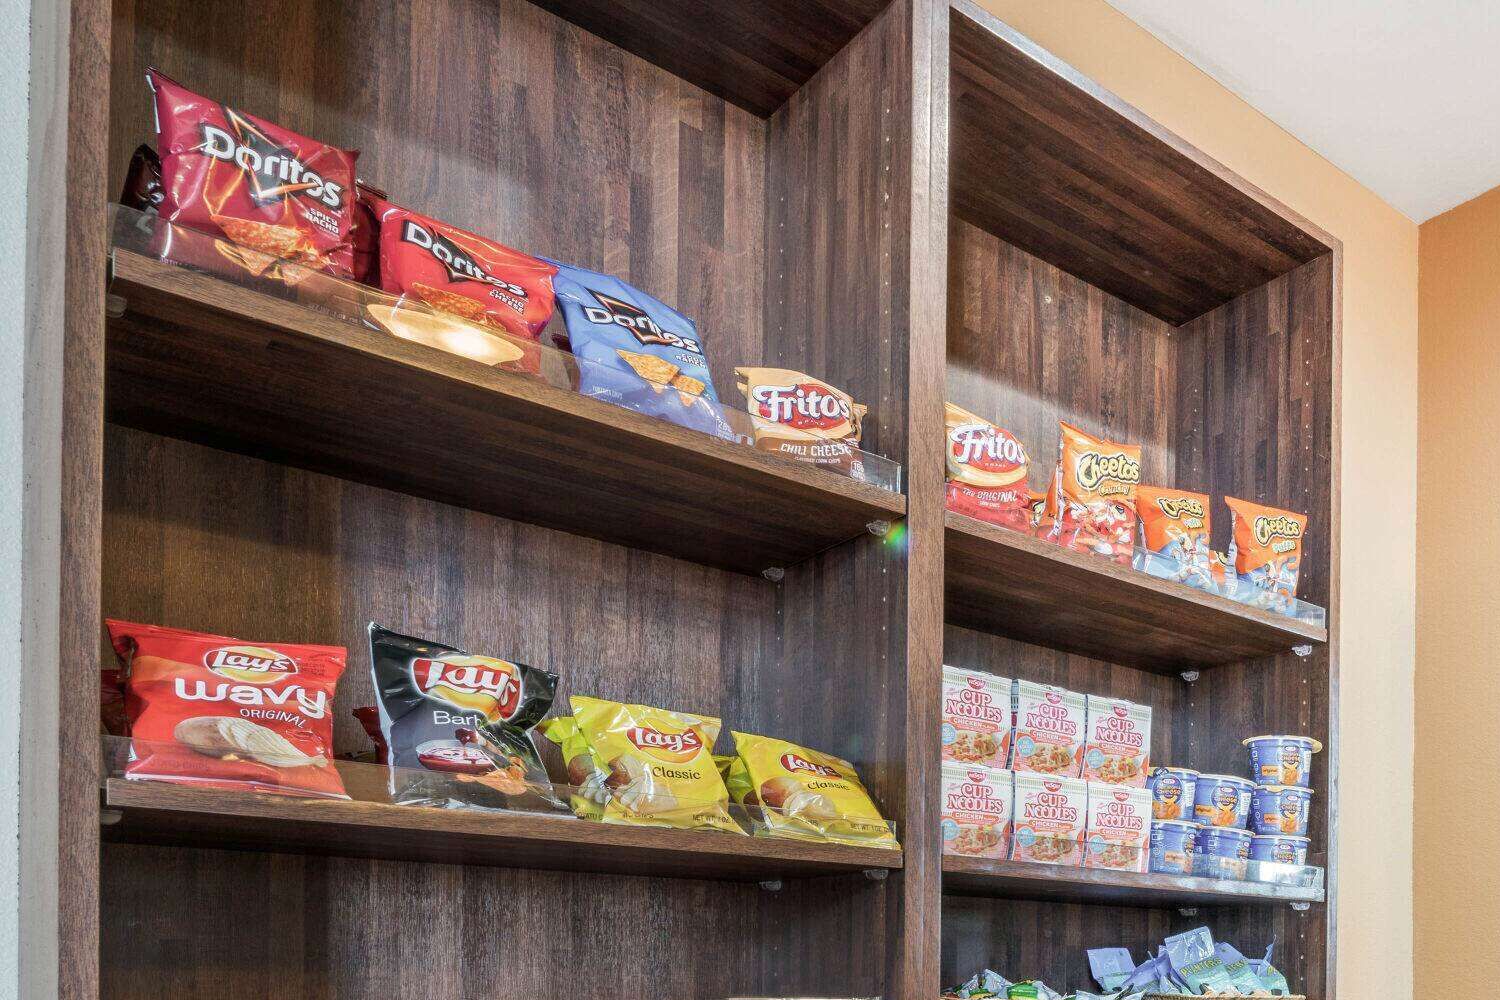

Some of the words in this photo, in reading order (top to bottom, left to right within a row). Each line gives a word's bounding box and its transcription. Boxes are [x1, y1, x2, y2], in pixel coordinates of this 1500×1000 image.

[201, 124, 345, 209] Doritos
[405, 221, 527, 297] Doritos
[752, 384, 850, 422] Fritos
[780, 443, 807, 455] CHILI
[811, 443, 851, 457] CHEESE
[950, 424, 1025, 464] Fritos
[1078, 453, 1140, 489] Cheetos
[1256, 516, 1300, 545] Cheetos
[212, 651, 289, 672] Lay's
[175, 677, 326, 718] wavy
[960, 689, 992, 705] CUP
[240, 708, 306, 729] ORIGINAL
[946, 699, 1002, 723] NOODLES
[1039, 704, 1068, 720] CUP
[1026, 714, 1077, 736] NOODLES
[1107, 717, 1135, 733] CUP
[635, 728, 697, 752] Lay's
[1096, 727, 1143, 747] NOODLES
[652, 766, 701, 780] Classic
[961, 783, 993, 799] CUP
[1037, 792, 1067, 807] CUP
[948, 794, 1004, 814] NOODLES
[1025, 803, 1077, 821] NOODLES
[1108, 802, 1135, 816] CUP
[1096, 813, 1143, 830] NOODLES
